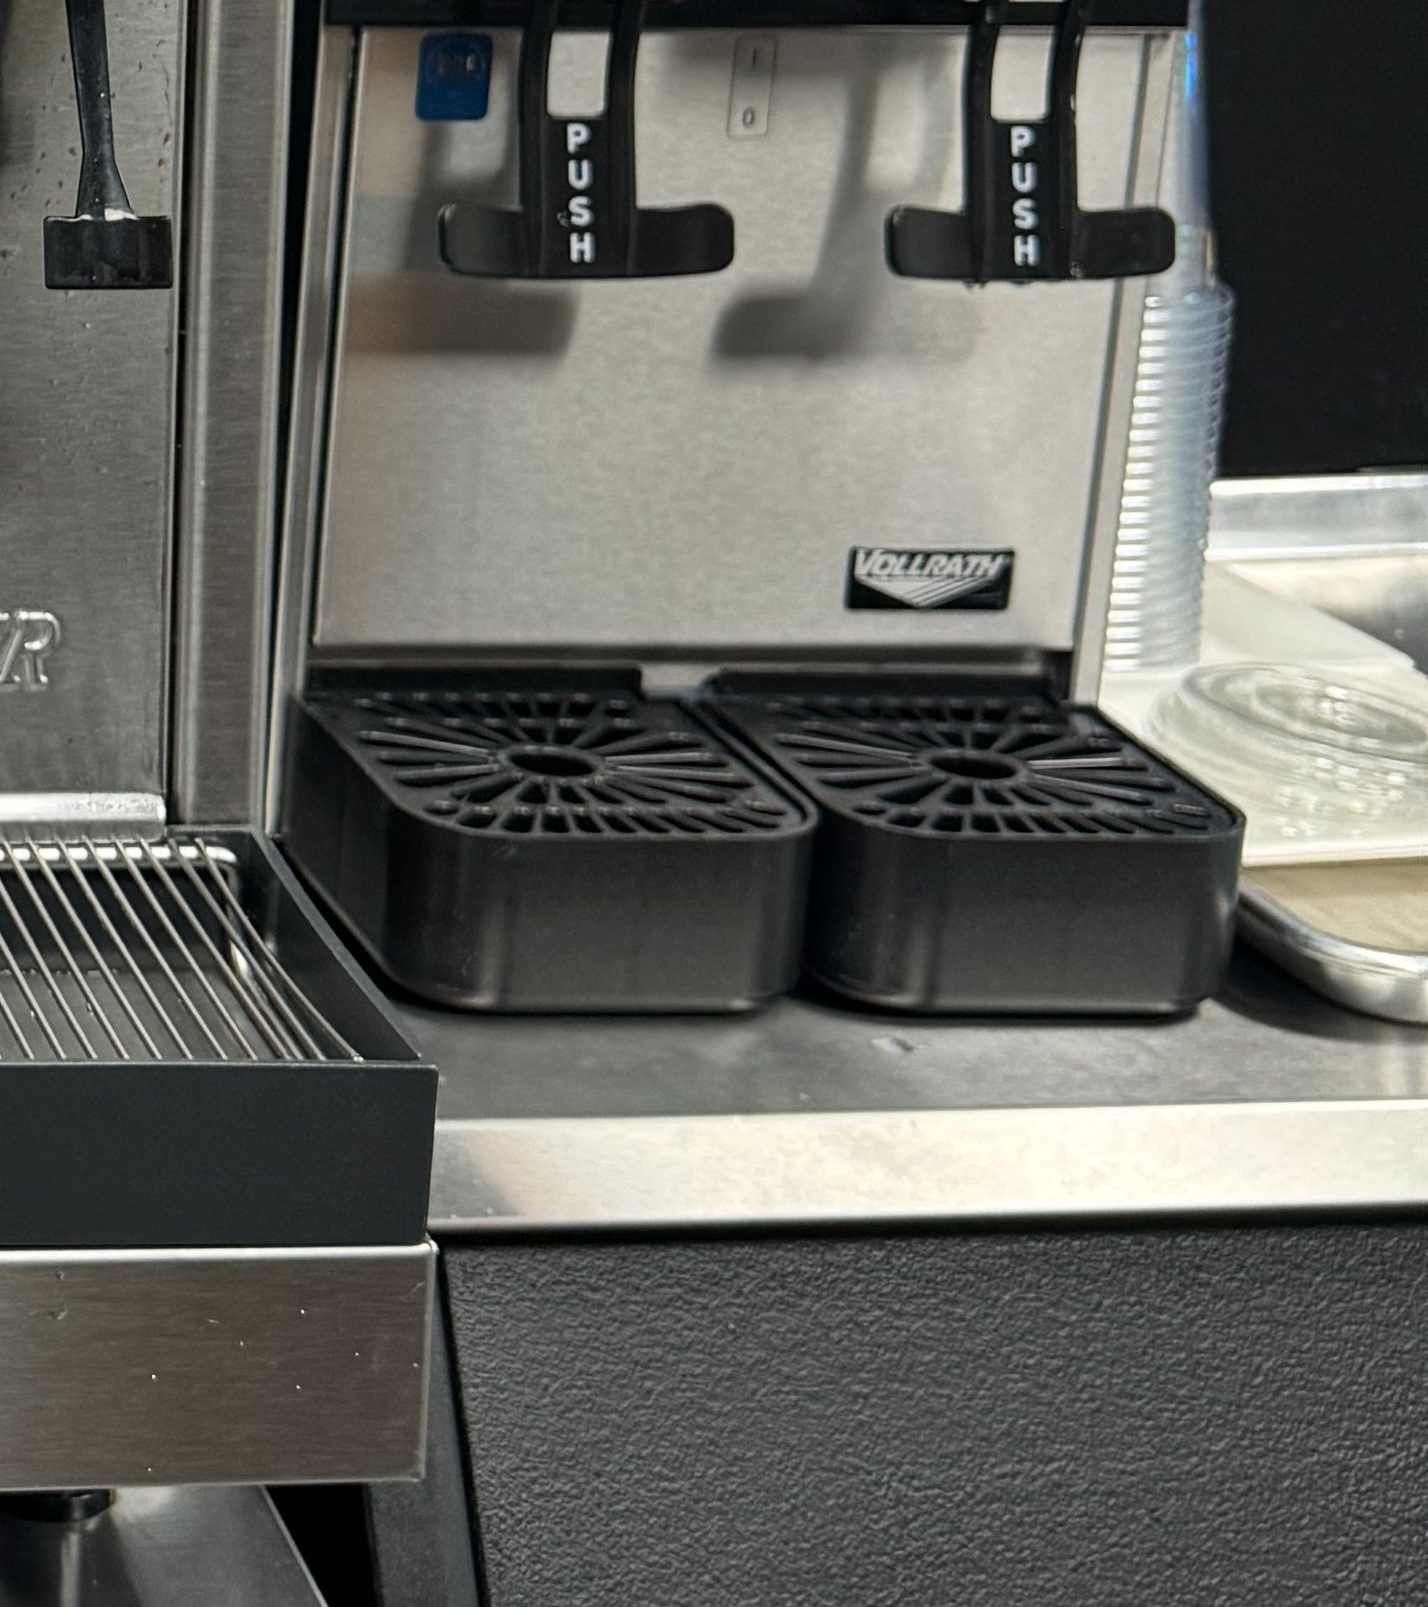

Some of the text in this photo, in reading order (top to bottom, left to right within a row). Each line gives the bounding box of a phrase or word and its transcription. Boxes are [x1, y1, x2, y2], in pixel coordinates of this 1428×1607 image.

[564, 121, 598, 266] PUSH
[1009, 124, 1041, 268] PUSH
[854, 546, 1004, 577] VOLLRATH
